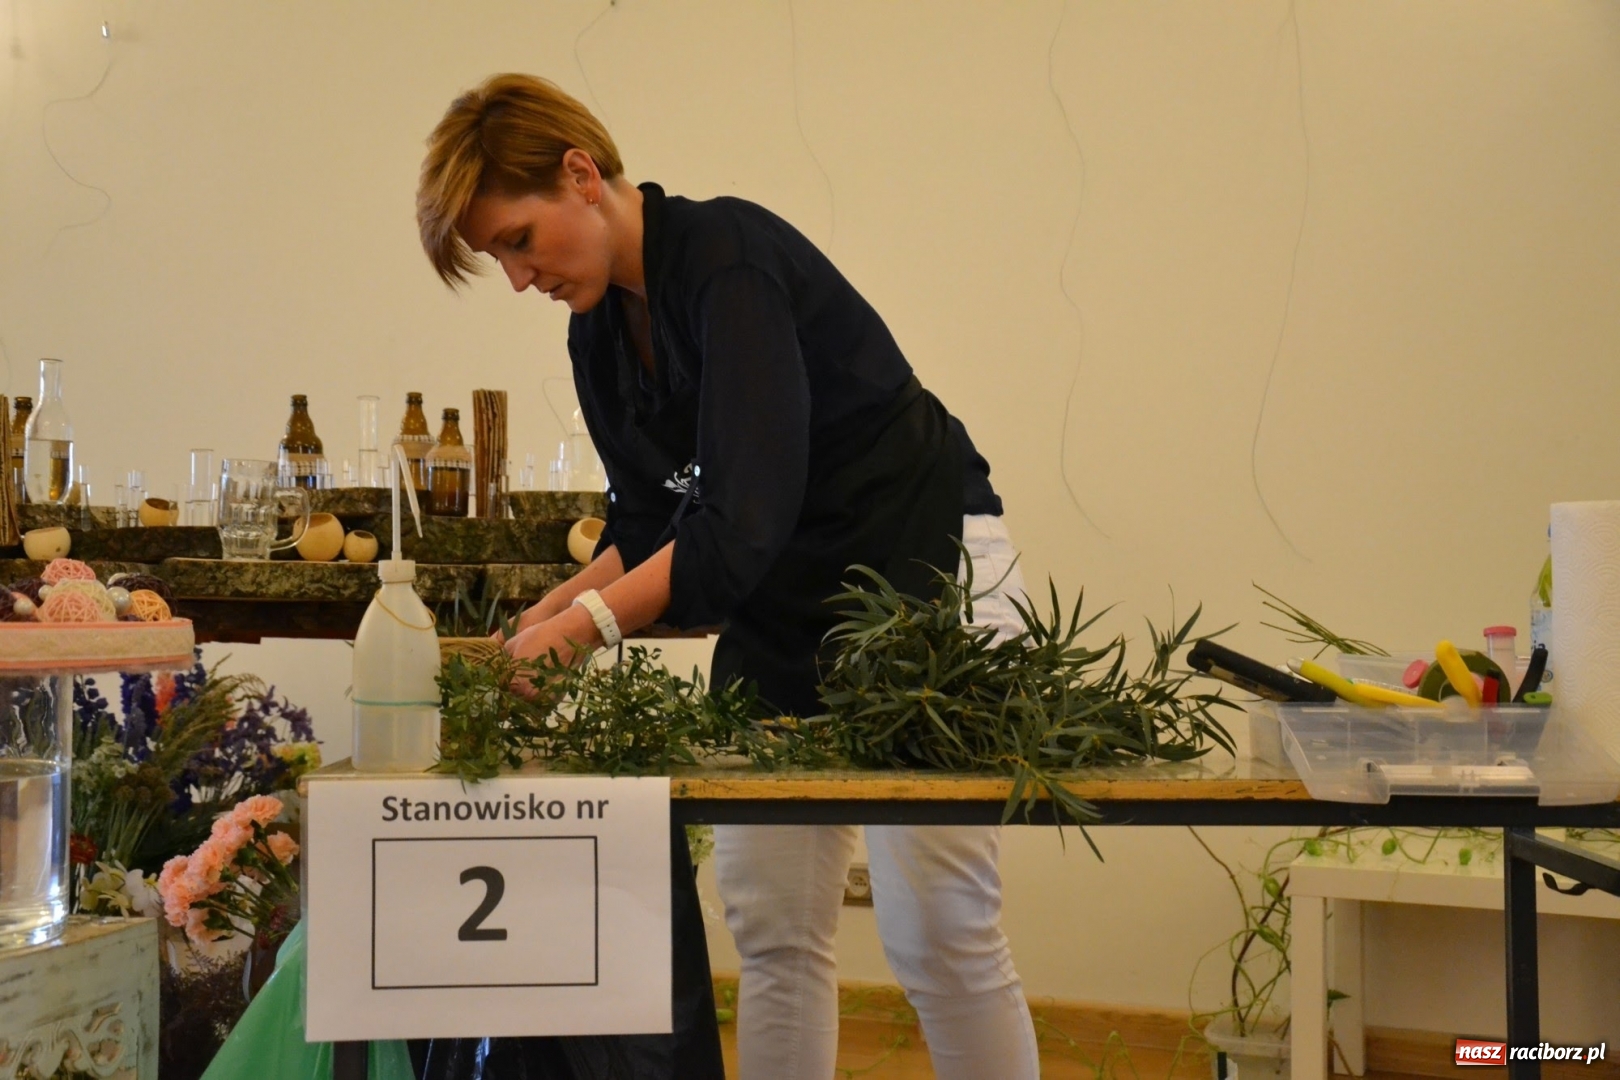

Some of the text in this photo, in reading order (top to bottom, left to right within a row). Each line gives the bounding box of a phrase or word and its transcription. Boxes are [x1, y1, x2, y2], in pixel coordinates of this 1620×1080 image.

[381, 793, 610, 822] Stanowisko nr
[457, 865, 508, 942] 2
